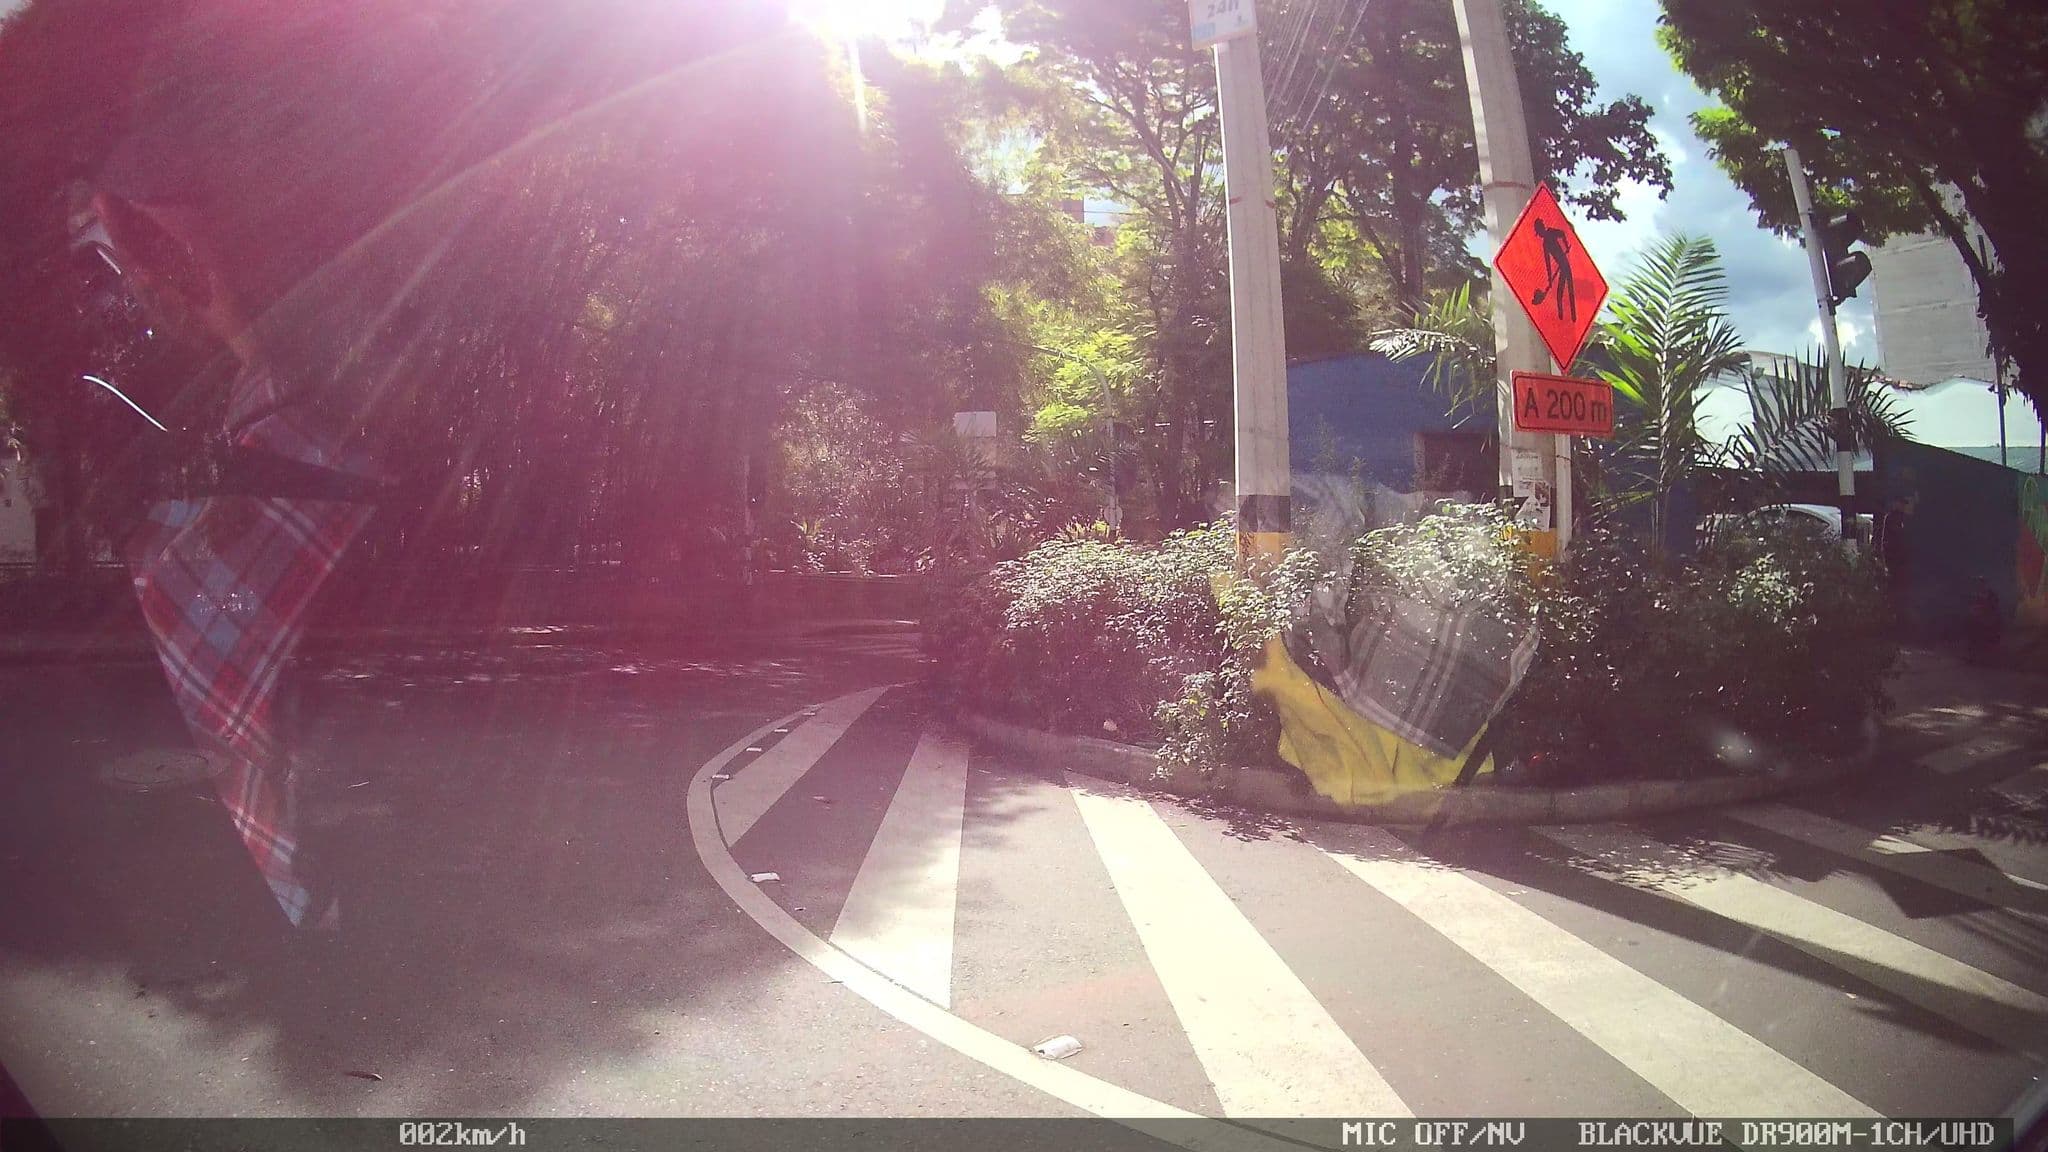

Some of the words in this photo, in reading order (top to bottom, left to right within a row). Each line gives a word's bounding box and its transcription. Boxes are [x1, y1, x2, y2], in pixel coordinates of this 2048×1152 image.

[1524, 387, 1540, 418] A
[1547, 389, 1586, 420] 200
[1591, 400, 1607, 422] m
